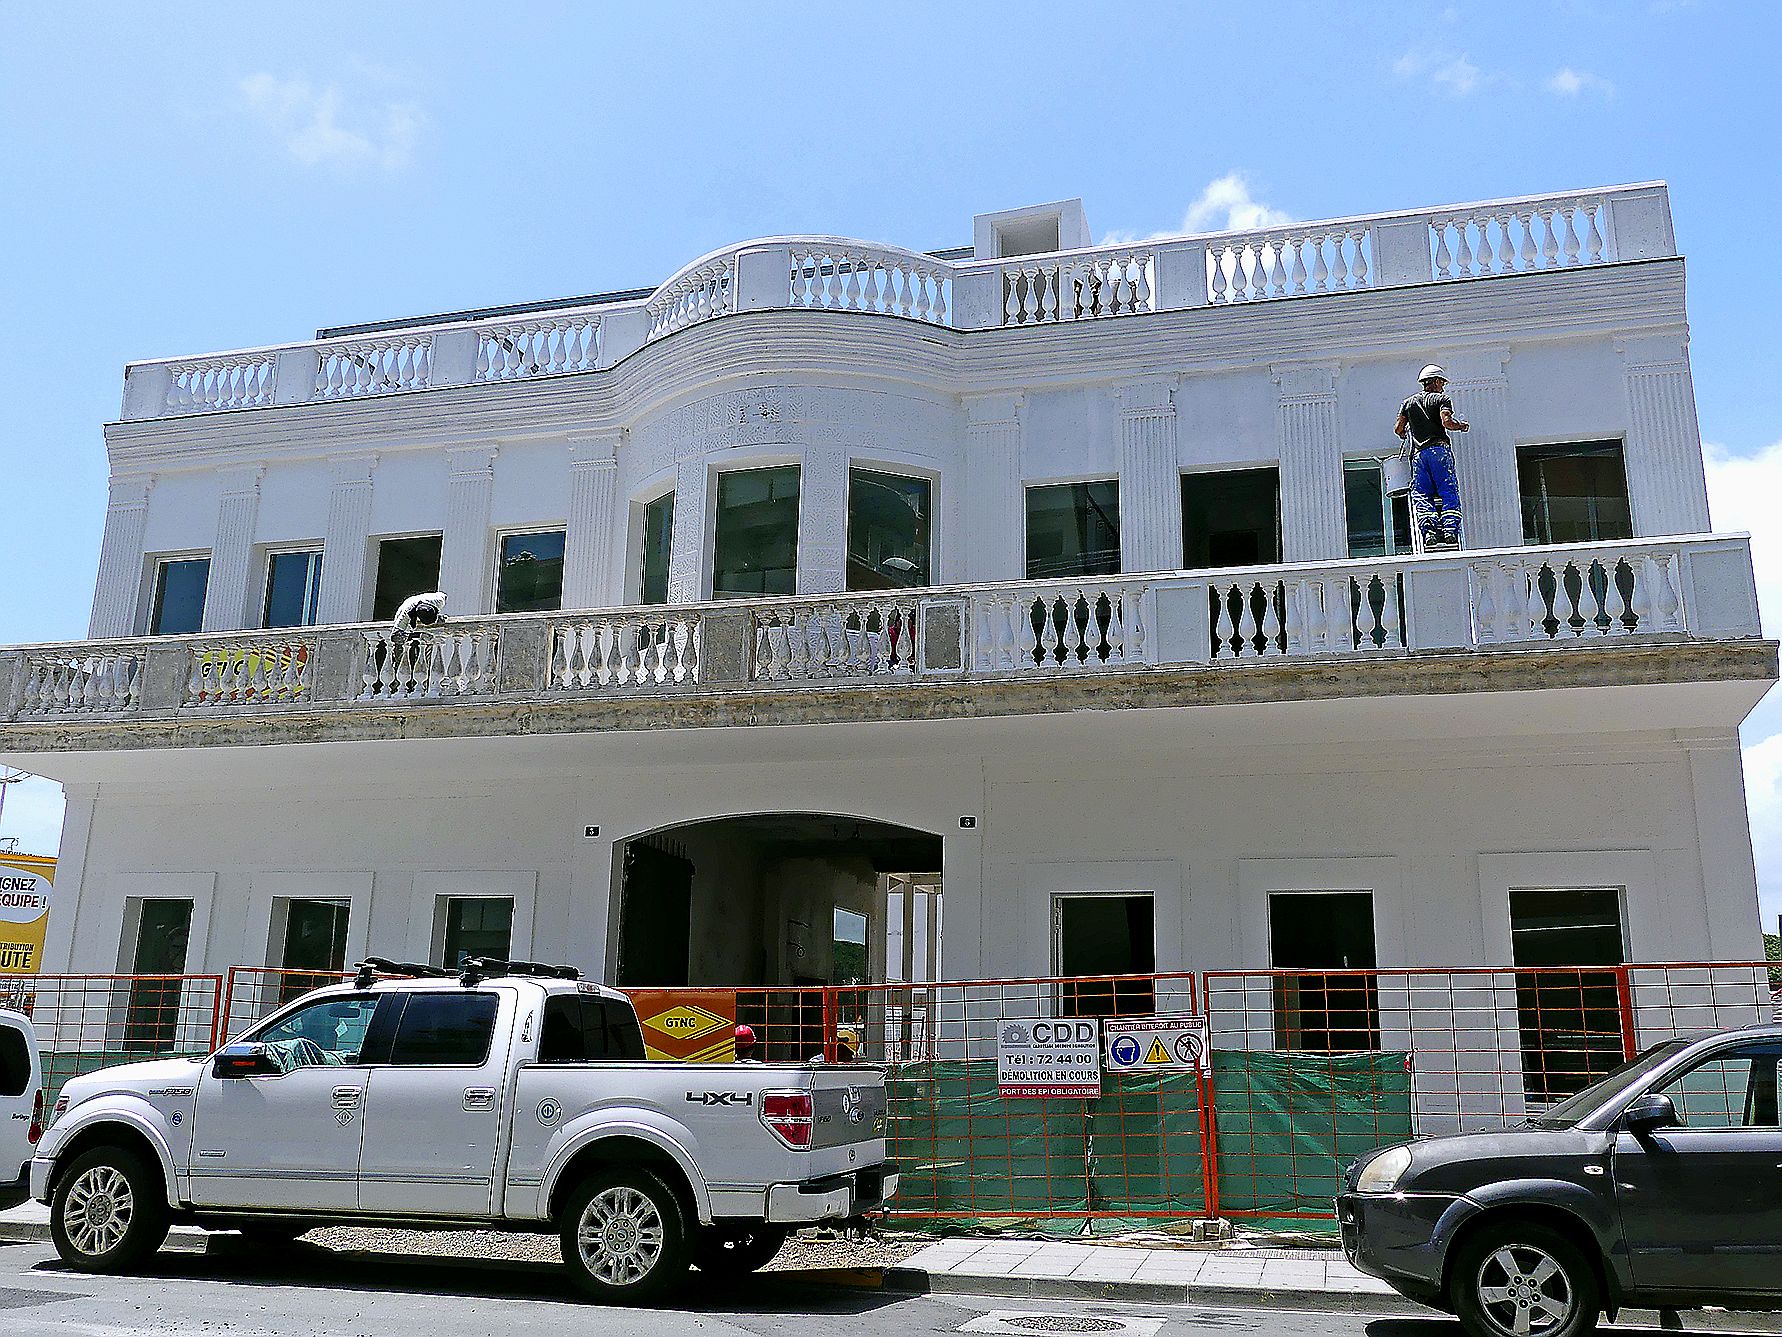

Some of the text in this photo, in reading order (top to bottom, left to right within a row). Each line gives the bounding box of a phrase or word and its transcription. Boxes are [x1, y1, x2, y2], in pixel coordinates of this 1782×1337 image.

[665, 1017, 696, 1028] GTNC
[1032, 1022, 1094, 1043] CDD
[1006, 1054, 1025, 1064] Tél
[1036, 1054, 1053, 1065] 72
[1056, 1054, 1072, 1065] 44
[1075, 1054, 1092, 1064] 00
[1001, 1069, 1099, 1080] DÉMOLITION EN COURS
